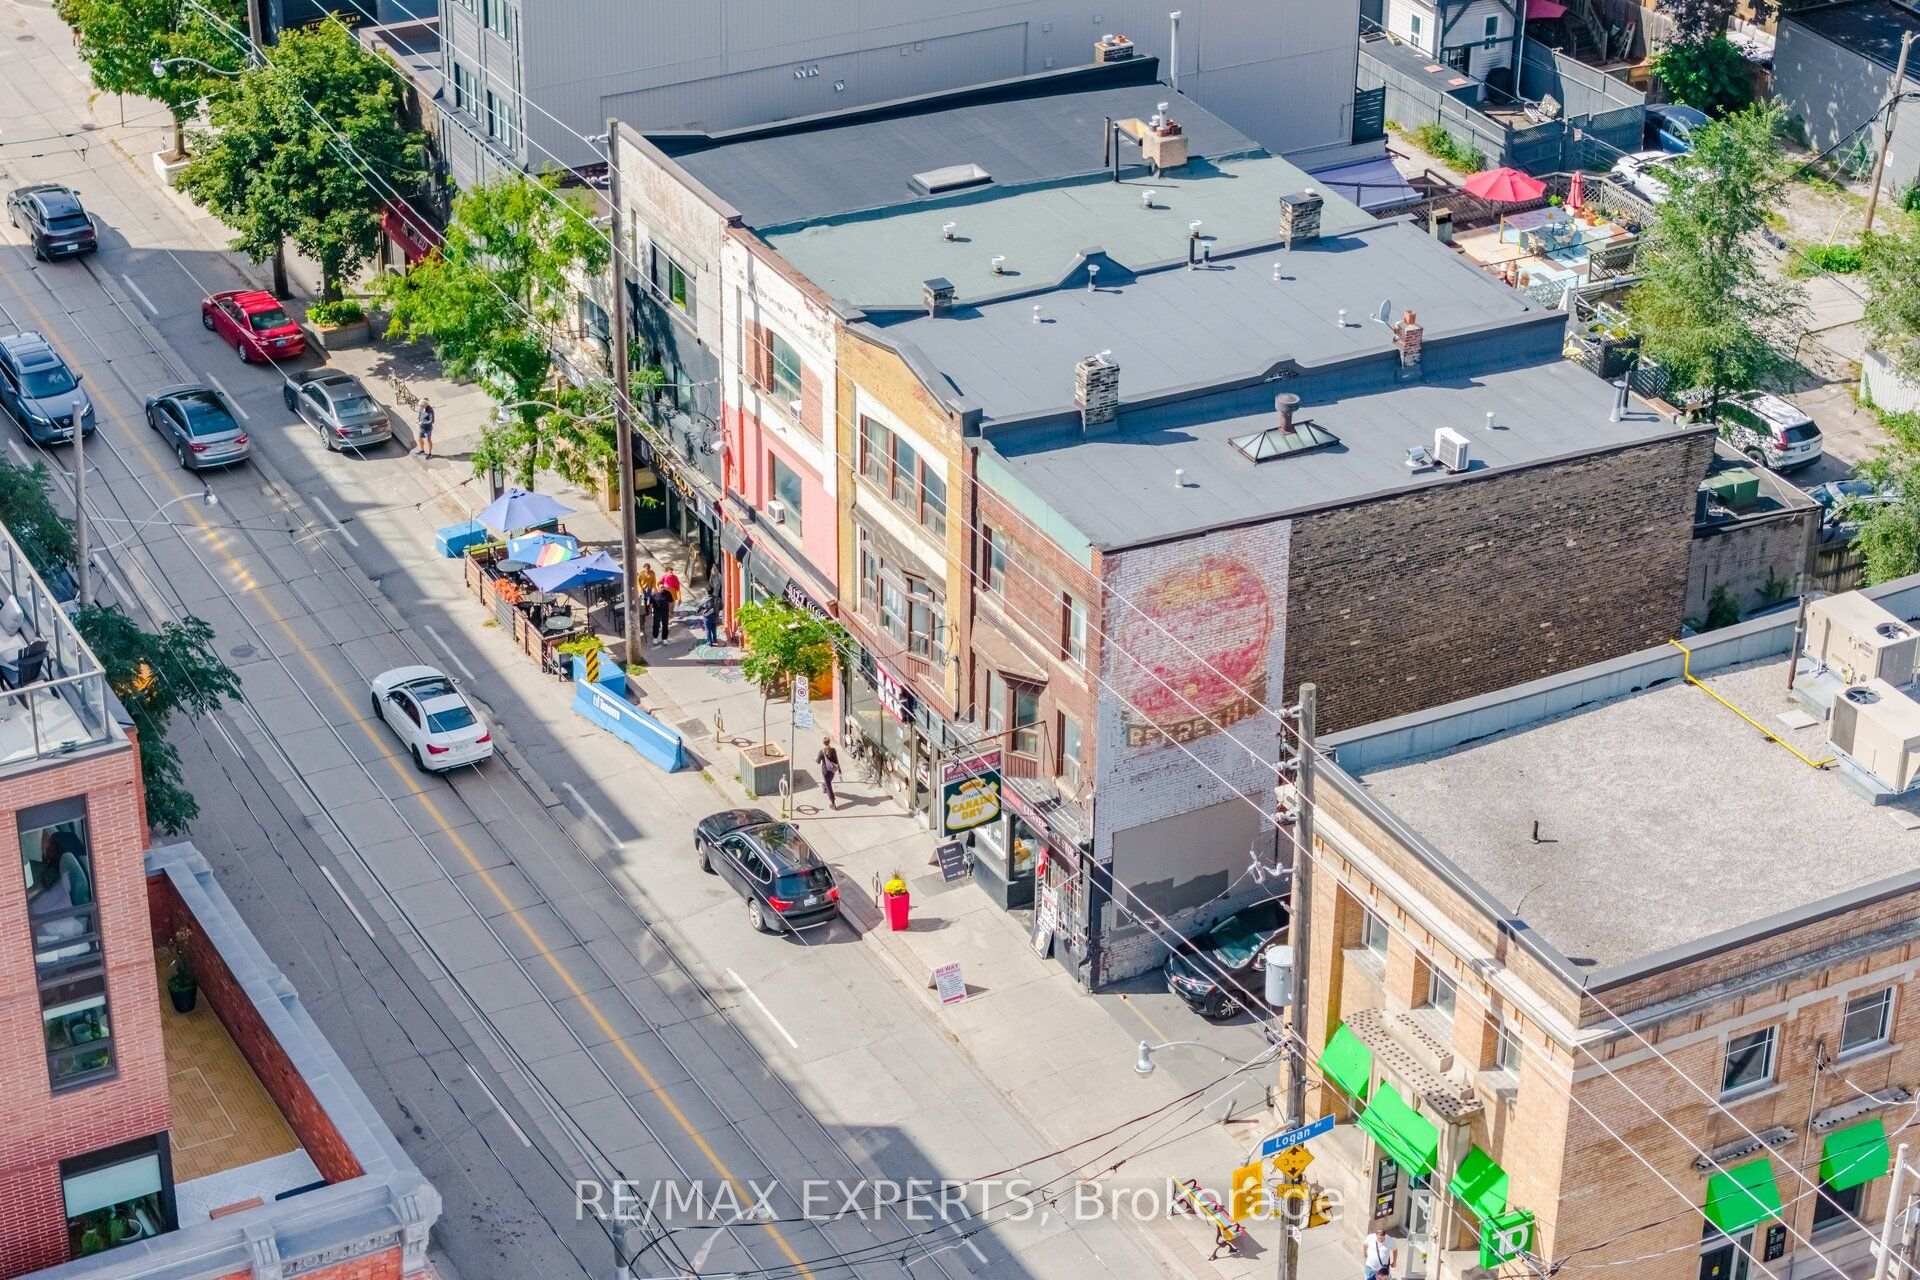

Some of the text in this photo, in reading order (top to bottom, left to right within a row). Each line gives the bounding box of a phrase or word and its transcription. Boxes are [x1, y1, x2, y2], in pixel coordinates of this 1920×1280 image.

[952, 794, 994, 814] CANADA
[961, 805, 984, 819] DRY
[1275, 1128, 1310, 1148] Logan
[1492, 1225, 1530, 1257] TD
